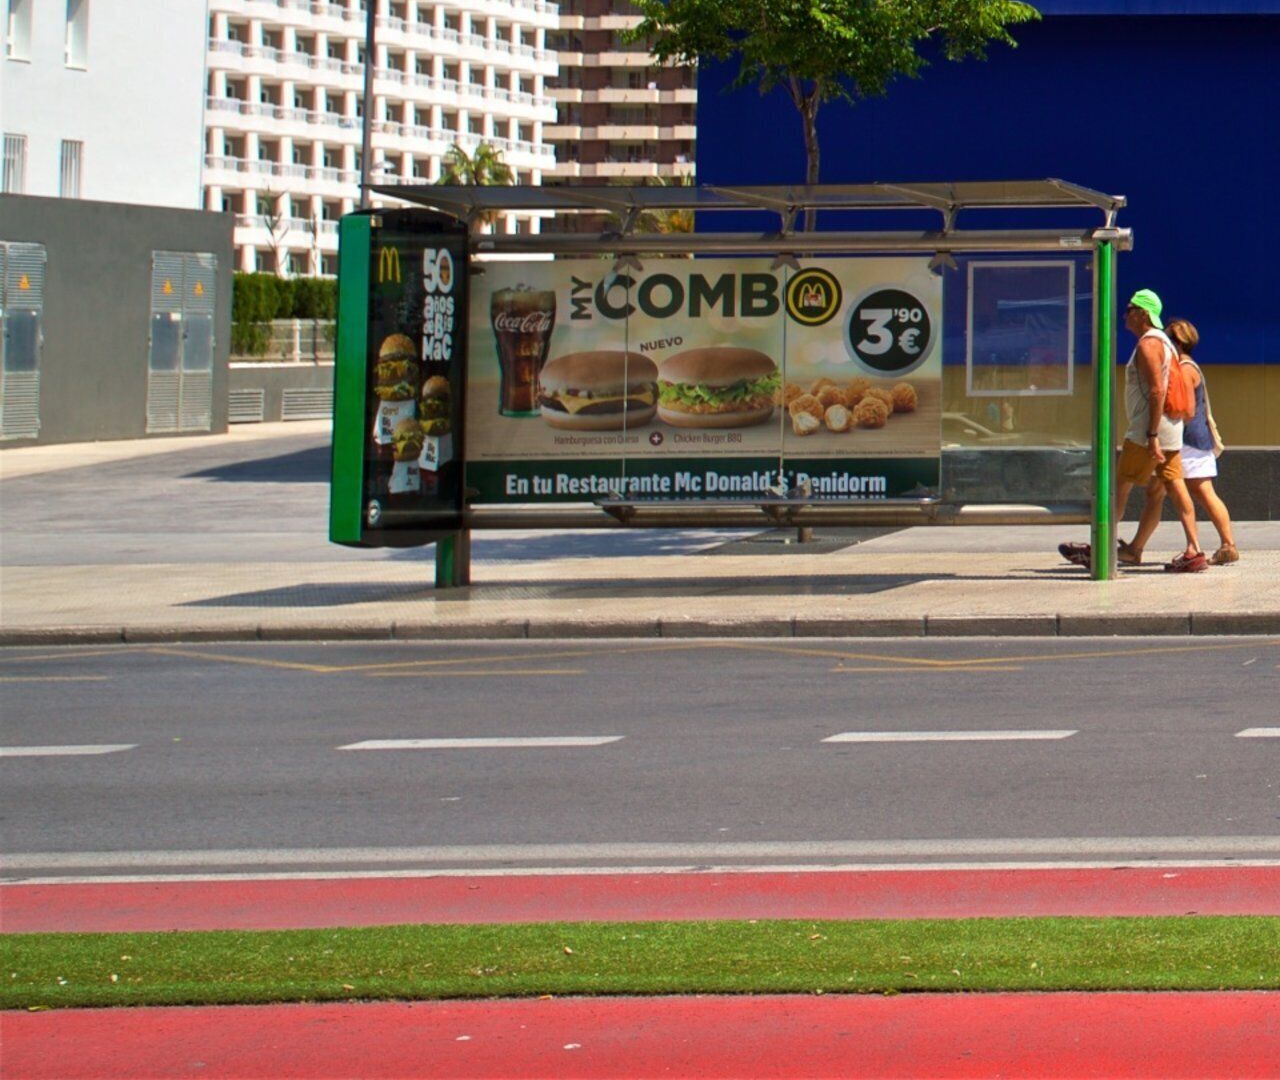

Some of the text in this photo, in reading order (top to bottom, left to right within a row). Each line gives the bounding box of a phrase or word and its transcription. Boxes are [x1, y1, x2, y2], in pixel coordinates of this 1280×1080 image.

[423, 247, 454, 294] 50
[570, 275, 593, 320] MY
[640, 336, 683, 352] NUEVO
[674, 432, 742, 444] Chicken Burger BBQ
[505, 474, 529, 495] En
[533, 476, 552, 495] tu
[556, 473, 671, 495] Restaurante
[675, 472, 701, 493] Mc
